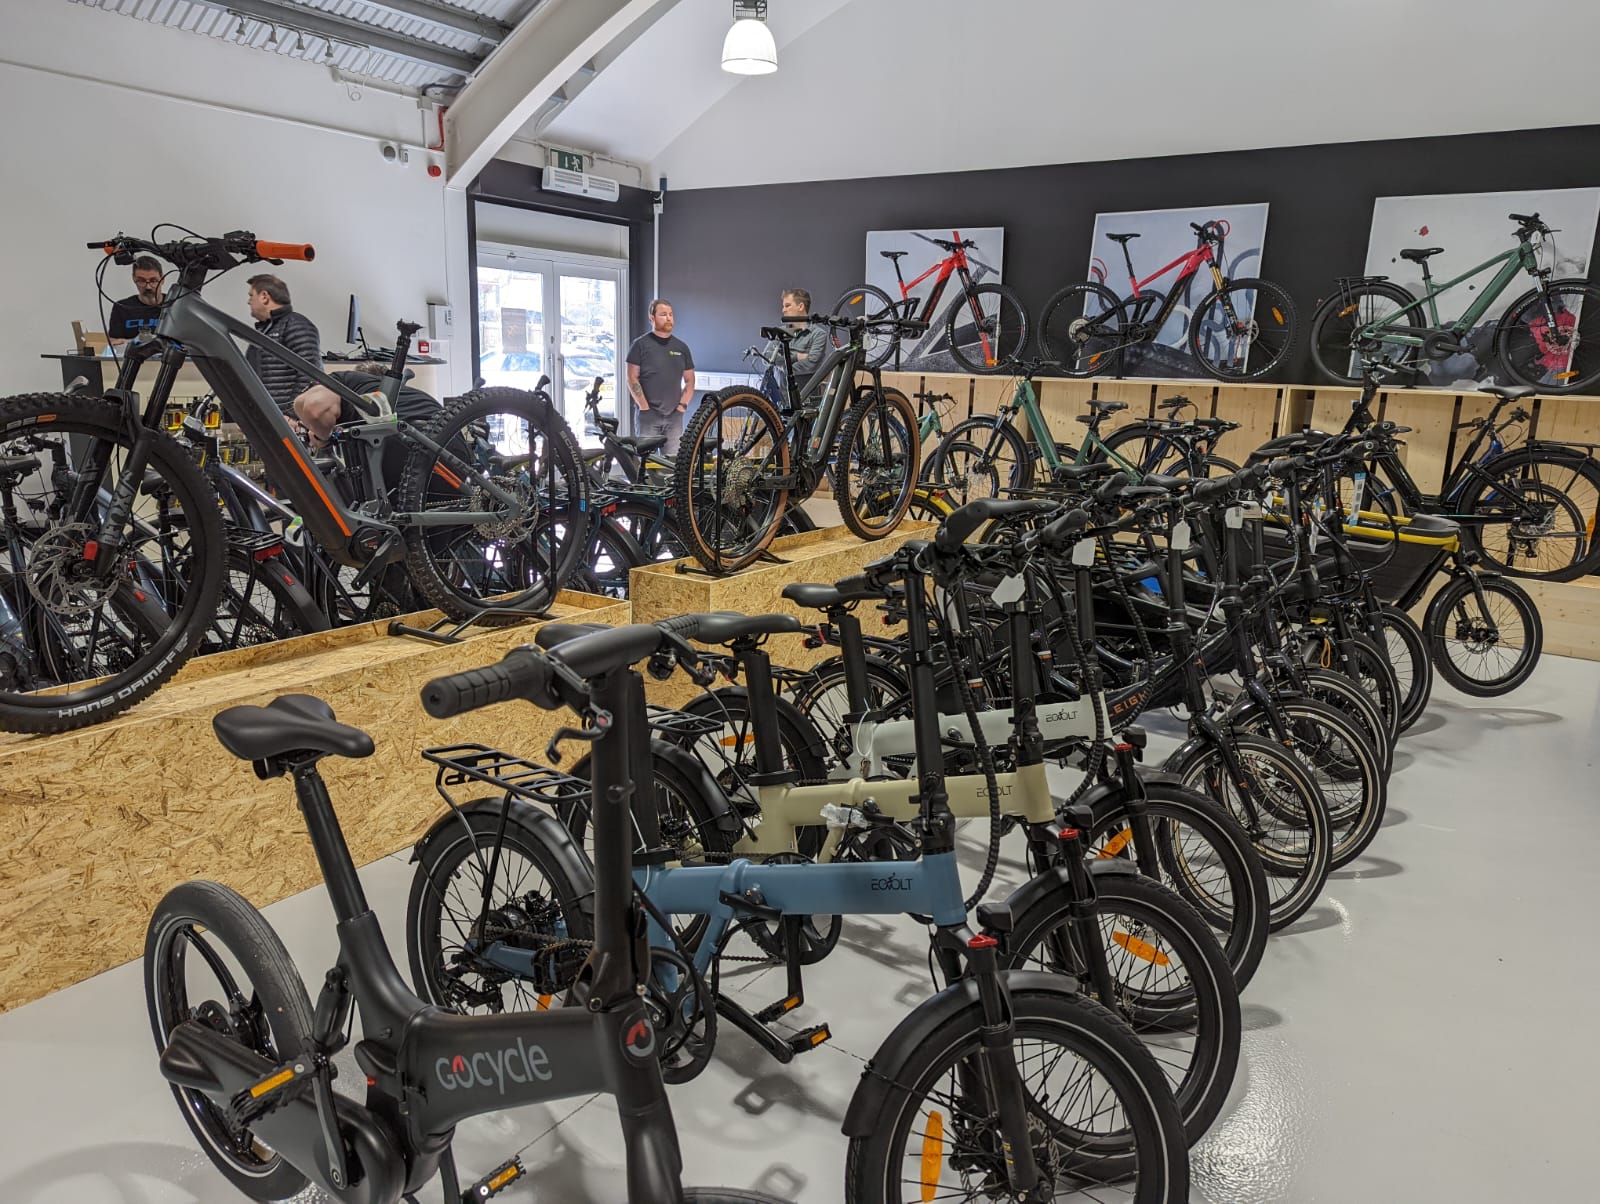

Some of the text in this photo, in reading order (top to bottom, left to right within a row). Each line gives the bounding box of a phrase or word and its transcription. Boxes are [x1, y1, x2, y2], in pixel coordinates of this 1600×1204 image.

[124, 318, 160, 329] CU
[559, 430, 586, 499] SCHWALBE
[58, 650, 176, 718] HANS DAMPF
